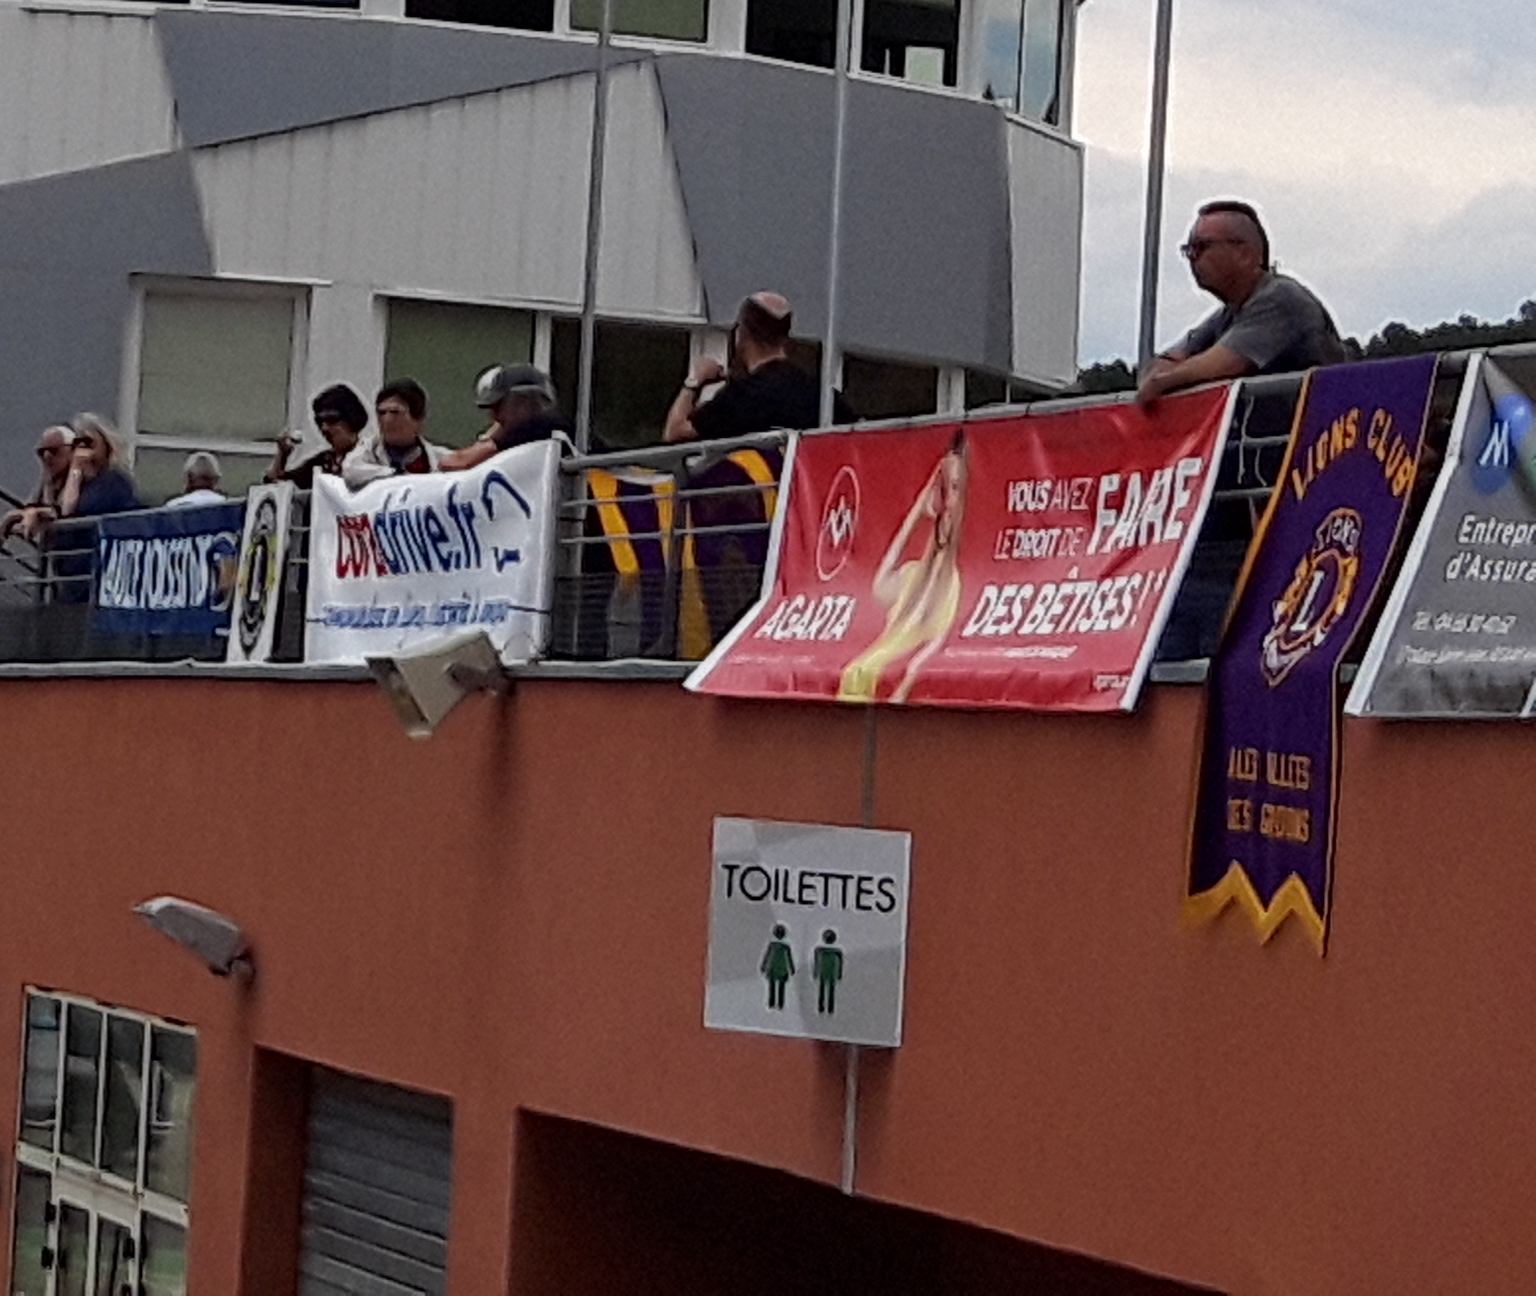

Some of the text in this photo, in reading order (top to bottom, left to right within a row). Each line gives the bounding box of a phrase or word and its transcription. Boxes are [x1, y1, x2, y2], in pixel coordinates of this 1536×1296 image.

[1292, 407, 1415, 500] LIONS CLUB
[1007, 477, 1094, 512] VOUS AVEZ
[961, 583, 1034, 638] DES
[721, 864, 896, 913] TOILETTES
